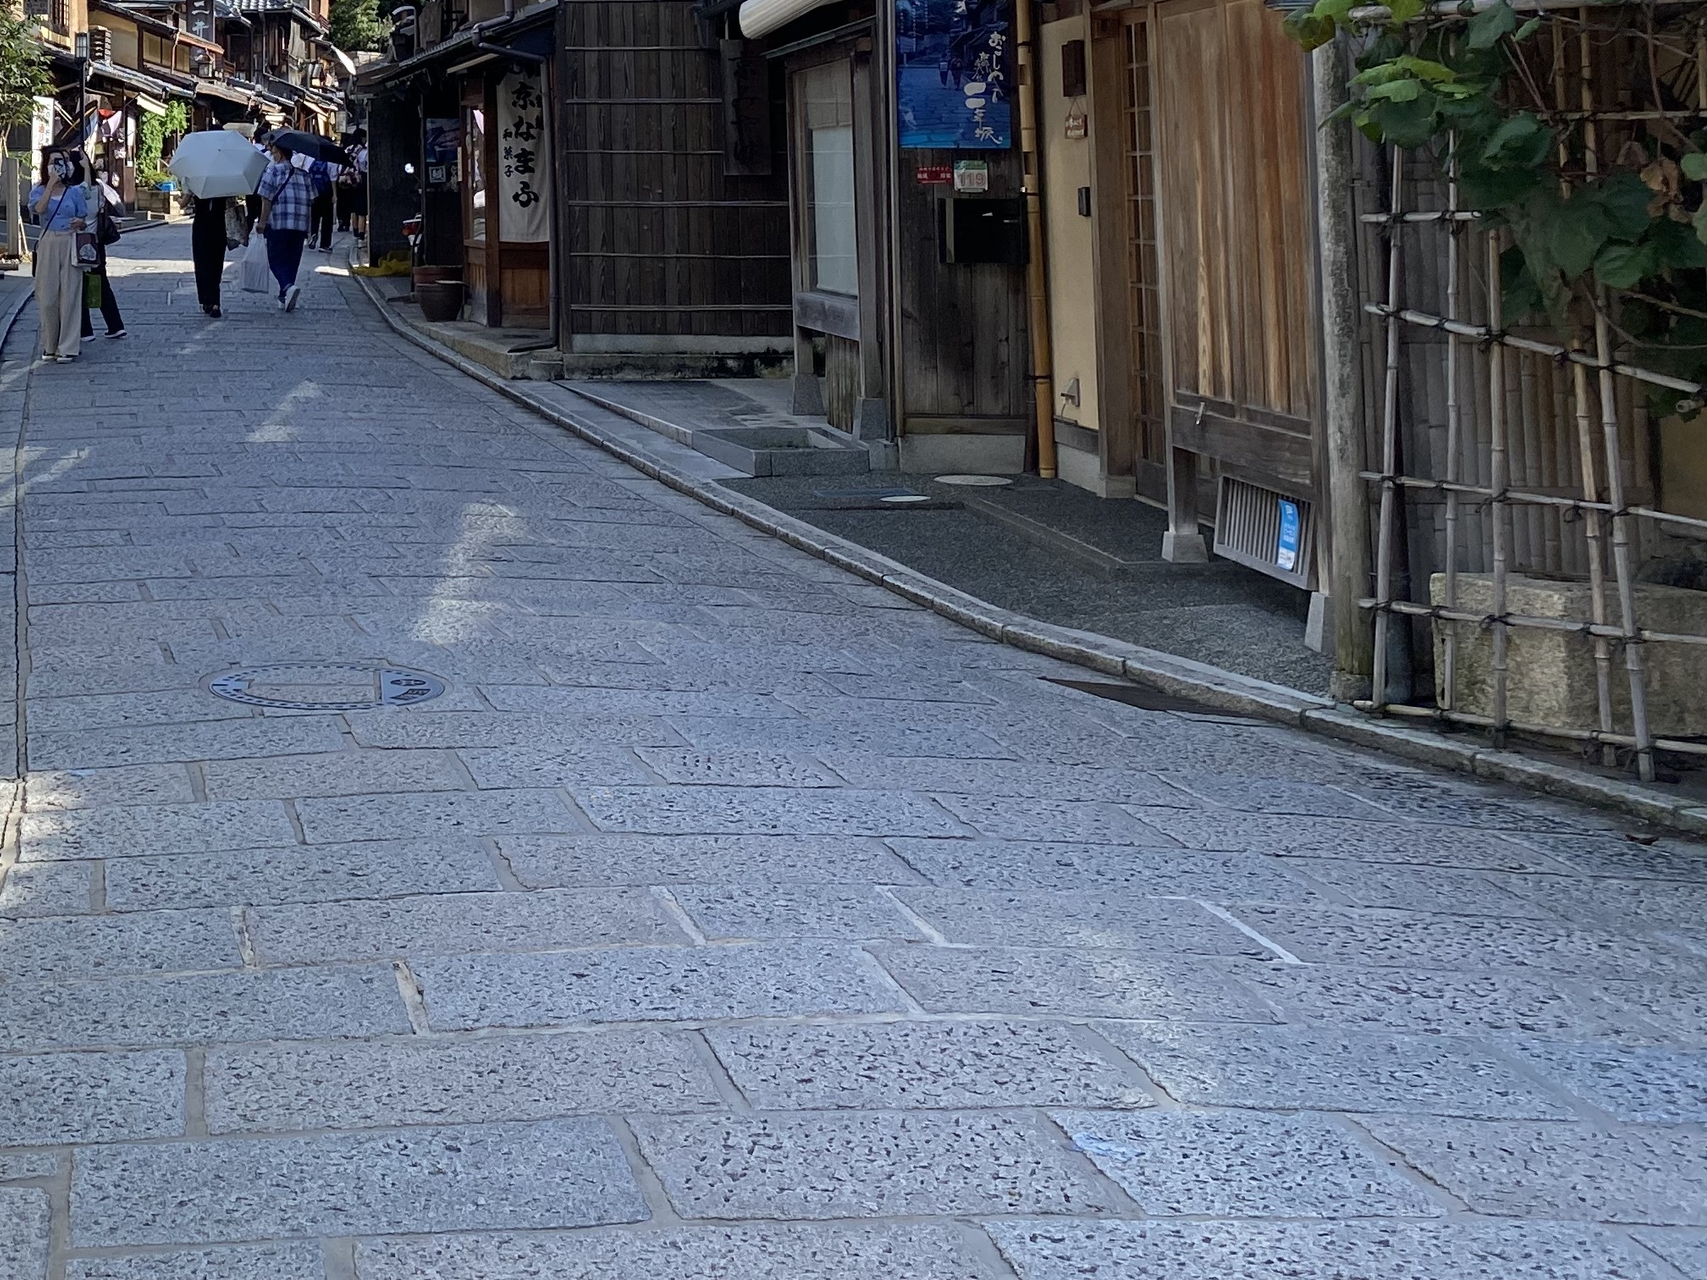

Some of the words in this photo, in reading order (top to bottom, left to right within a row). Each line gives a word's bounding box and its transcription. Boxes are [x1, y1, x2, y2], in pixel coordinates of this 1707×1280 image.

[502, 128, 514, 178] 和菓子
[511, 81, 540, 208] 京なまふ
[957, 171, 986, 188] 119
